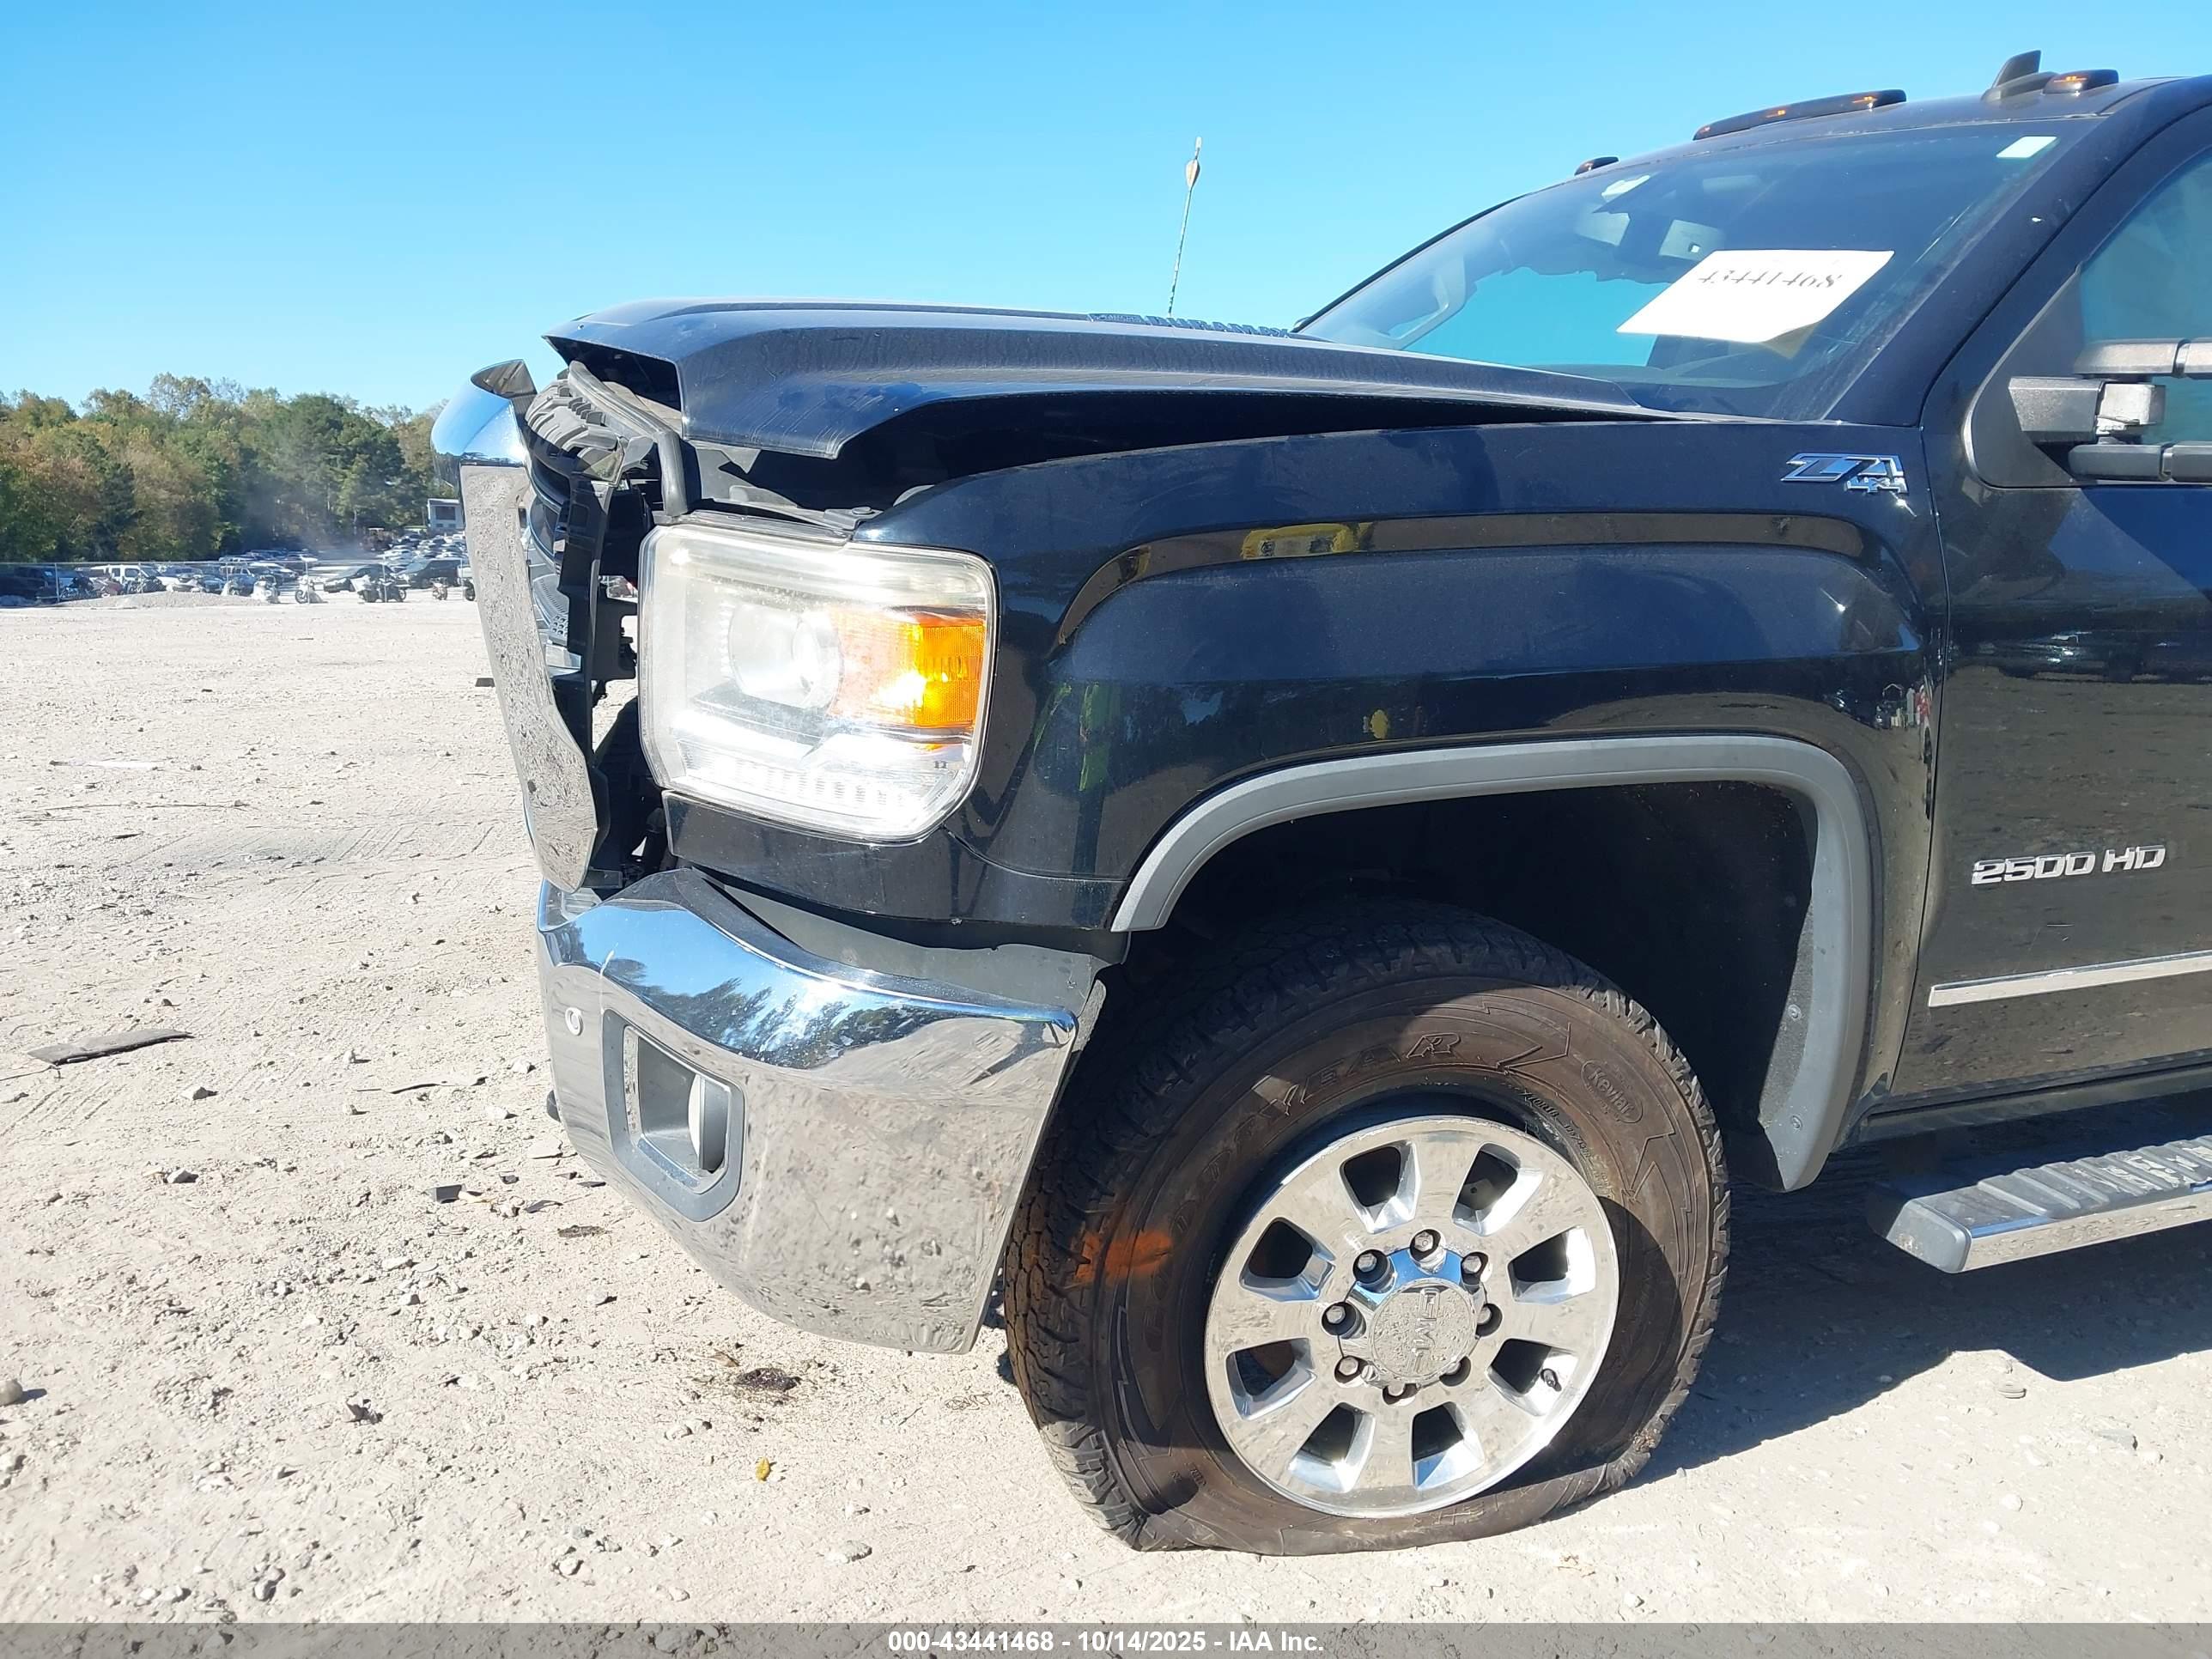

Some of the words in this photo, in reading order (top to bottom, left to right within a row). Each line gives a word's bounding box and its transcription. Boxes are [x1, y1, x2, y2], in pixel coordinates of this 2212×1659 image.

[1971, 851, 2096, 885] 2500
[2102, 844, 2166, 873] HD
[1588, 1066, 1635, 1114] Kevlar
